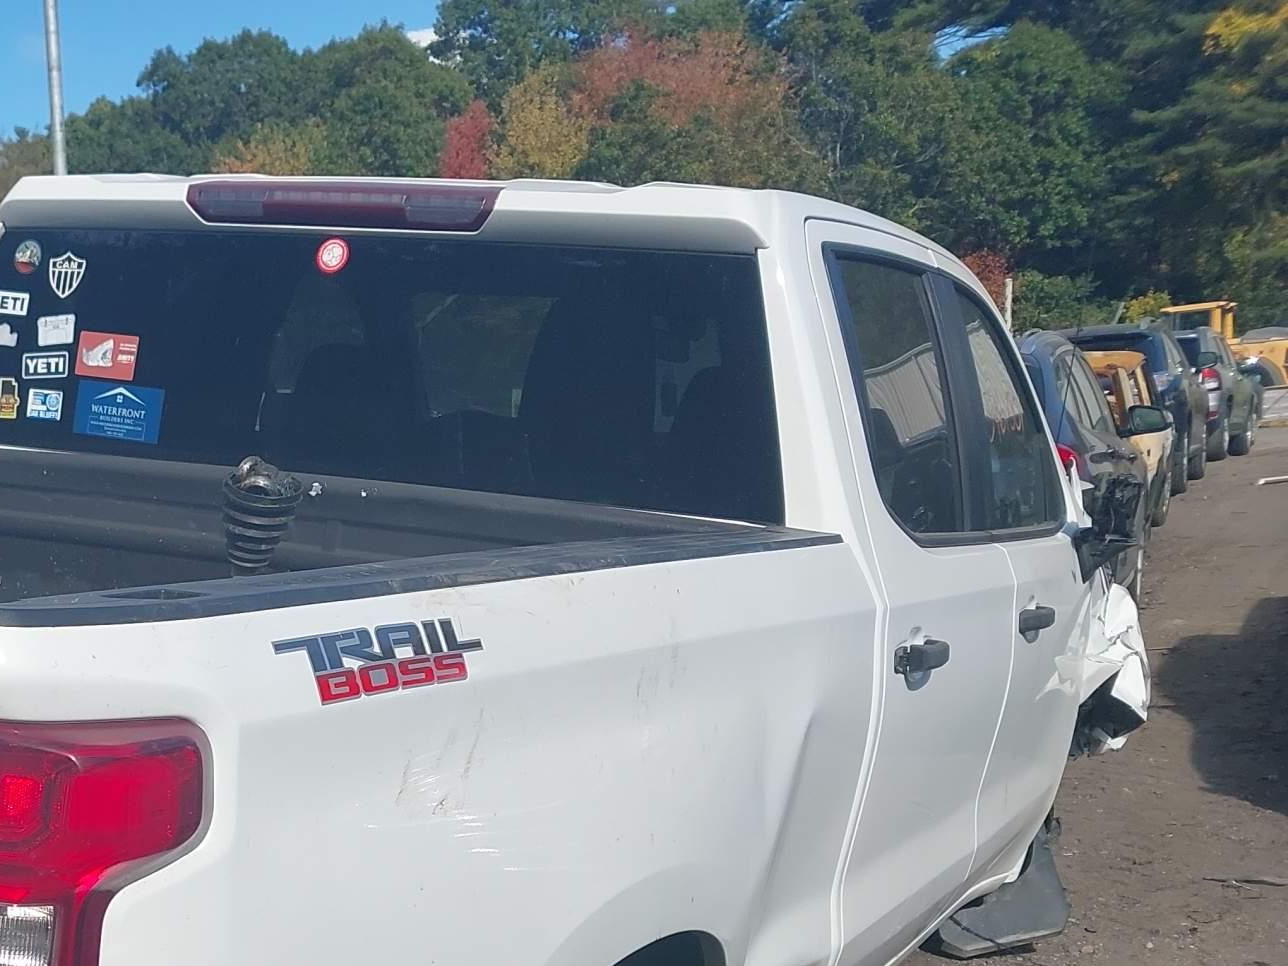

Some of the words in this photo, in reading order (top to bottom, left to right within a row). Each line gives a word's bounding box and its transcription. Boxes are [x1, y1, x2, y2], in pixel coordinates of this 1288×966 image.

[56, 261, 79, 269] CAM
[26, 357, 64, 374] YETI
[91, 403, 146, 419] WATERFRONT
[271, 617, 484, 673] TRAIL
[314, 651, 469, 706] BOSS
